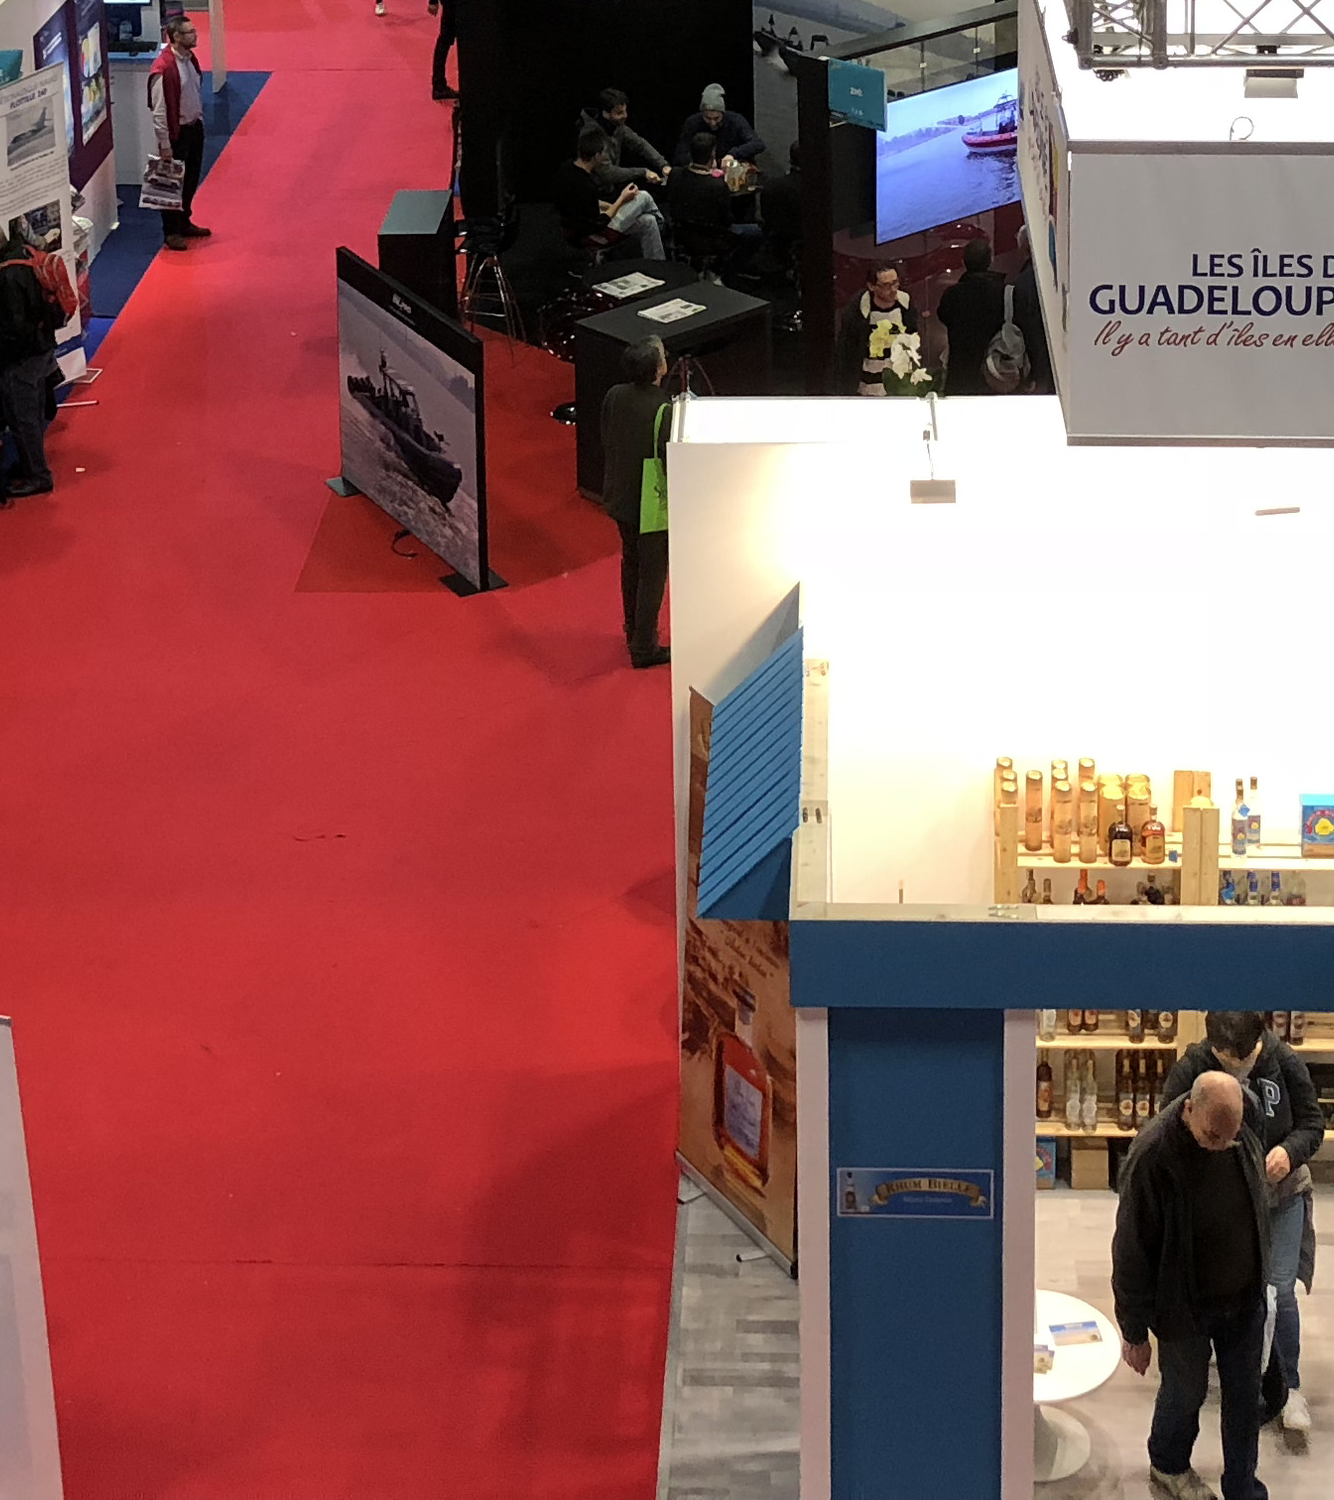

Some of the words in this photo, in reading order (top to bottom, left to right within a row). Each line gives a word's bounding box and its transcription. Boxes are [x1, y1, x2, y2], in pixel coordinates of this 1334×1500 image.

[1192, 253, 1244, 279] LES
[1251, 248, 1314, 279] ÎLES
[1094, 319, 1114, 347] Il
[1112, 330, 1136, 357] y
[1137, 331, 1154, 348] a
[1157, 326, 1204, 348] tant
[1205, 320, 1271, 348] d'îles
[1271, 332, 1301, 348] en
[886, 1179, 922, 1194] RHUM
